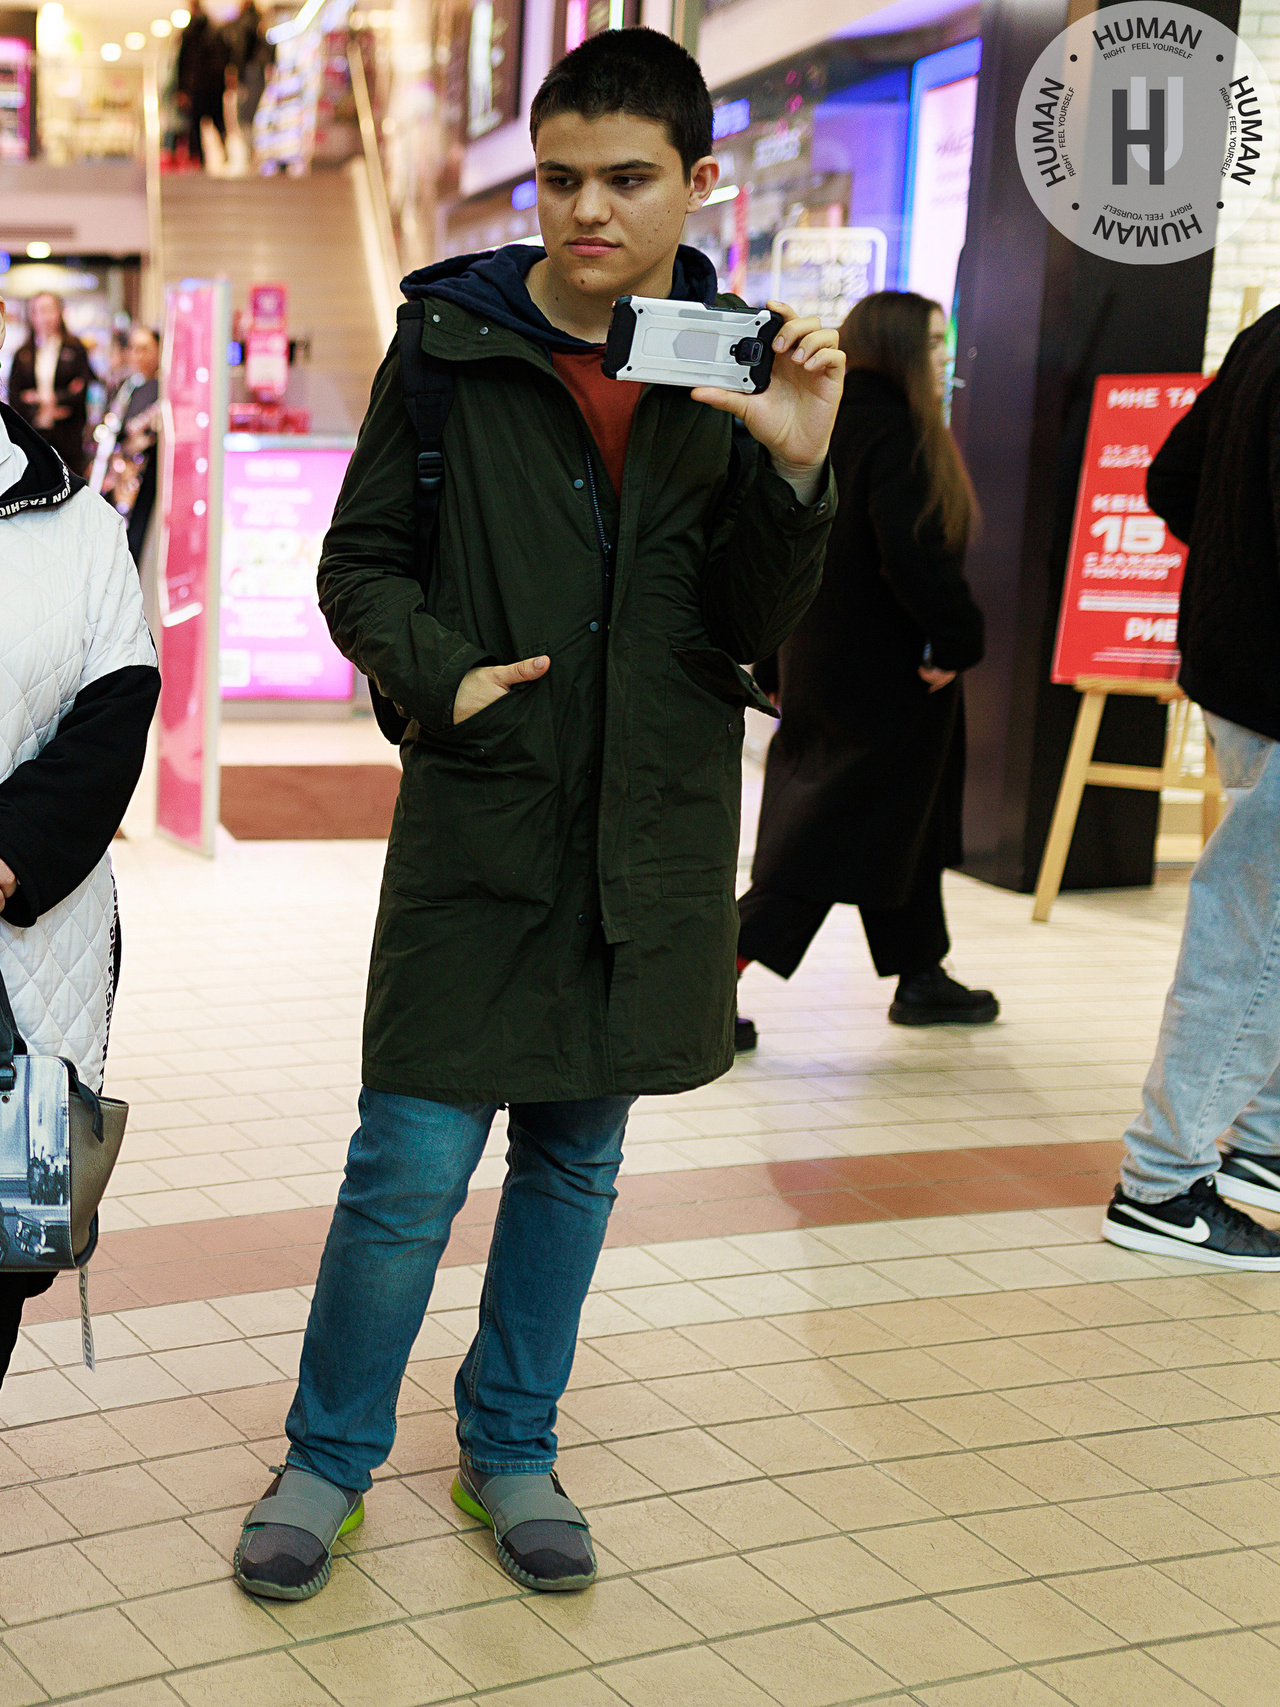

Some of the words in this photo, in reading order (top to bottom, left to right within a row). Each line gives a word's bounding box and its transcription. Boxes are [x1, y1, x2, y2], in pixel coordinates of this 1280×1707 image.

[1107, 387, 1160, 409] МНЕ
[1165, 387, 1197, 409] ТА
[1091, 493, 1151, 513] КЕШ
[1090, 515, 1166, 554] 15
